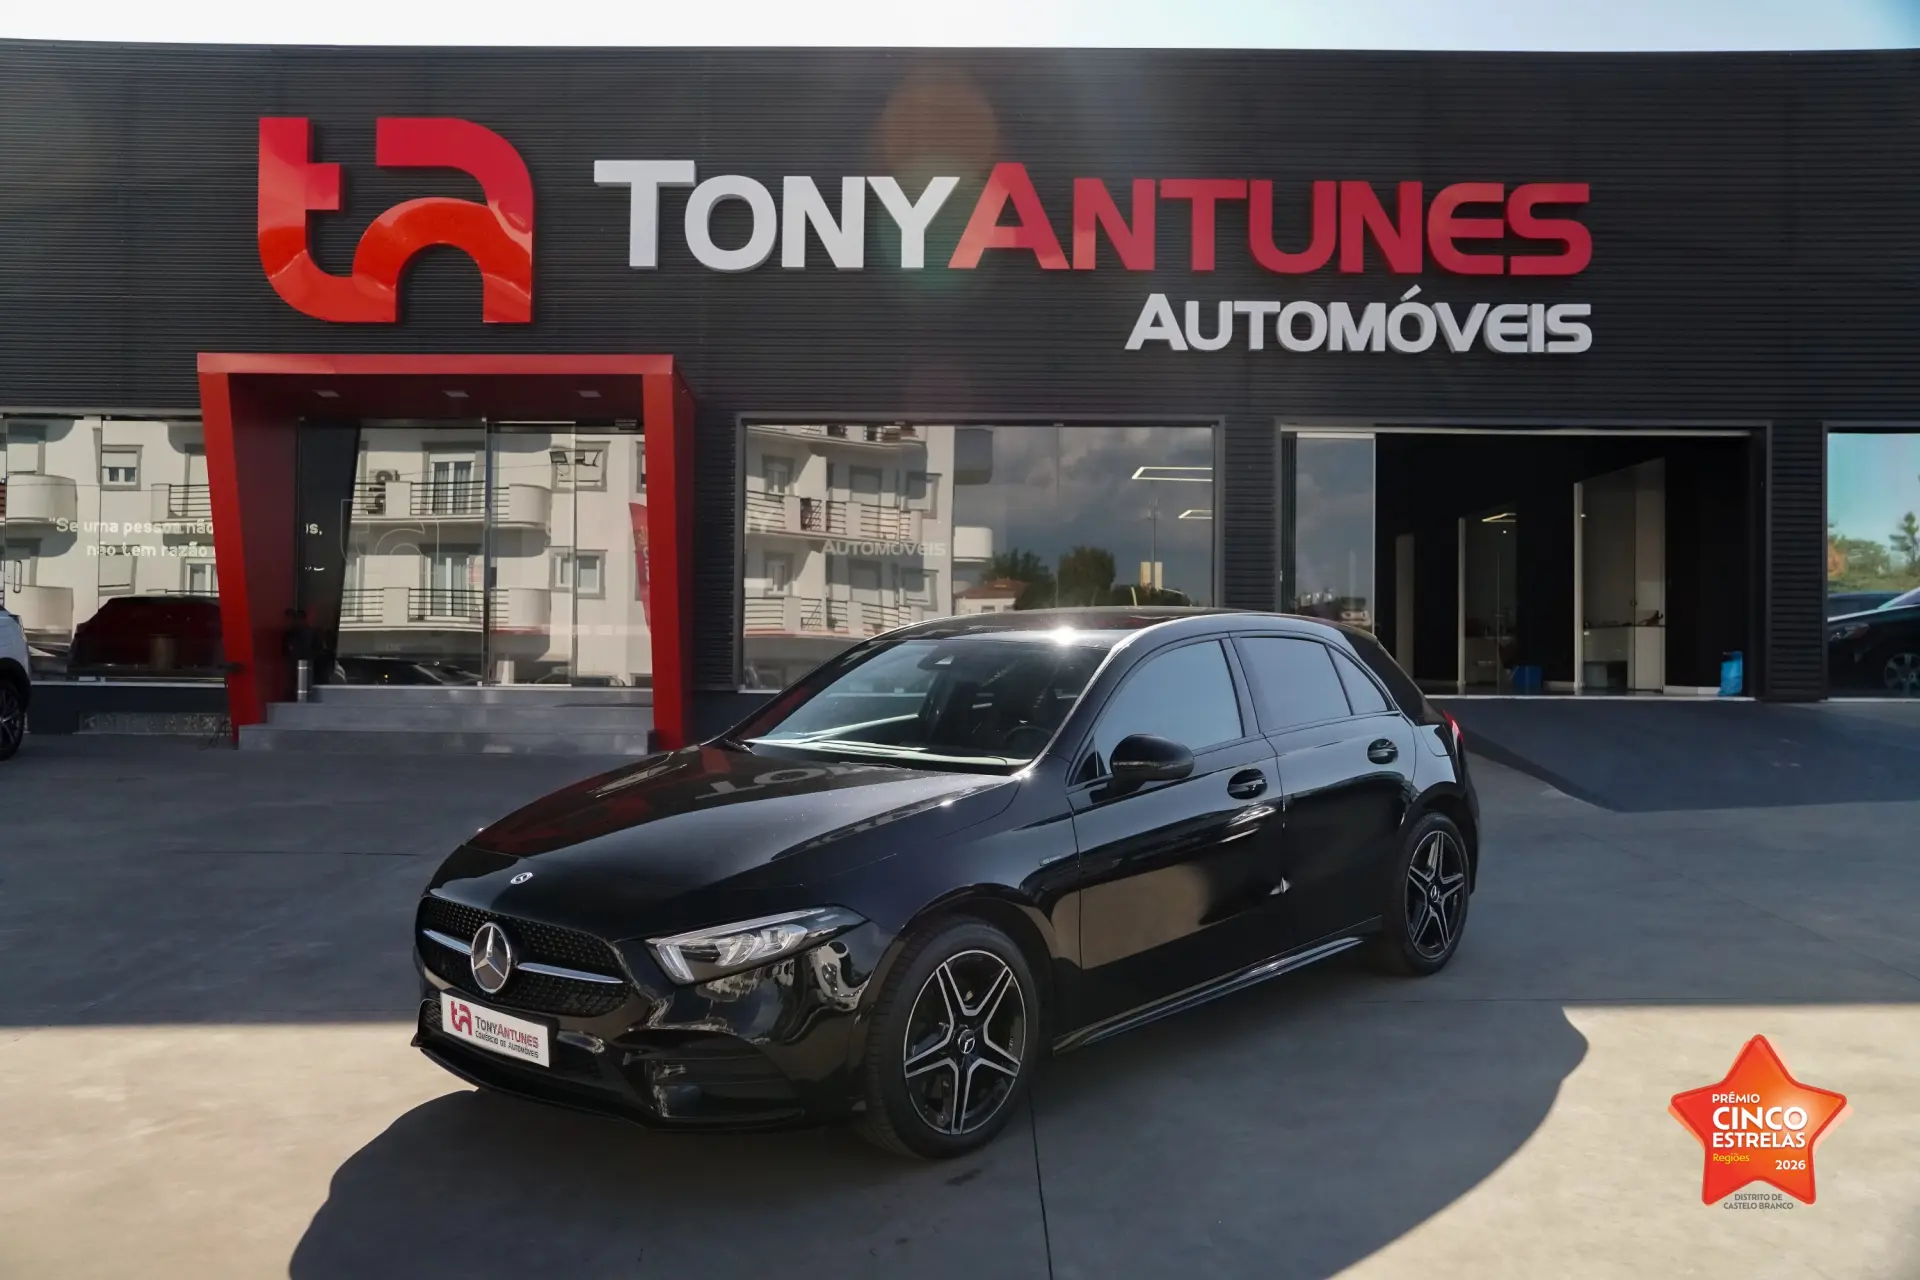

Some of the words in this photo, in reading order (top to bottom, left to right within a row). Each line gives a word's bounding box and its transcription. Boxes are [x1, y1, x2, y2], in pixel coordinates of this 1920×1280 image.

[1124, 284, 1593, 354] AUTOMÓVEIS
[84, 522, 118, 534] uma
[122, 521, 184, 538] pessoa
[87, 542, 115, 557] não
[122, 543, 156, 557] tem
[161, 541, 207, 557] razão
[499, 1039, 507, 1048] DE
